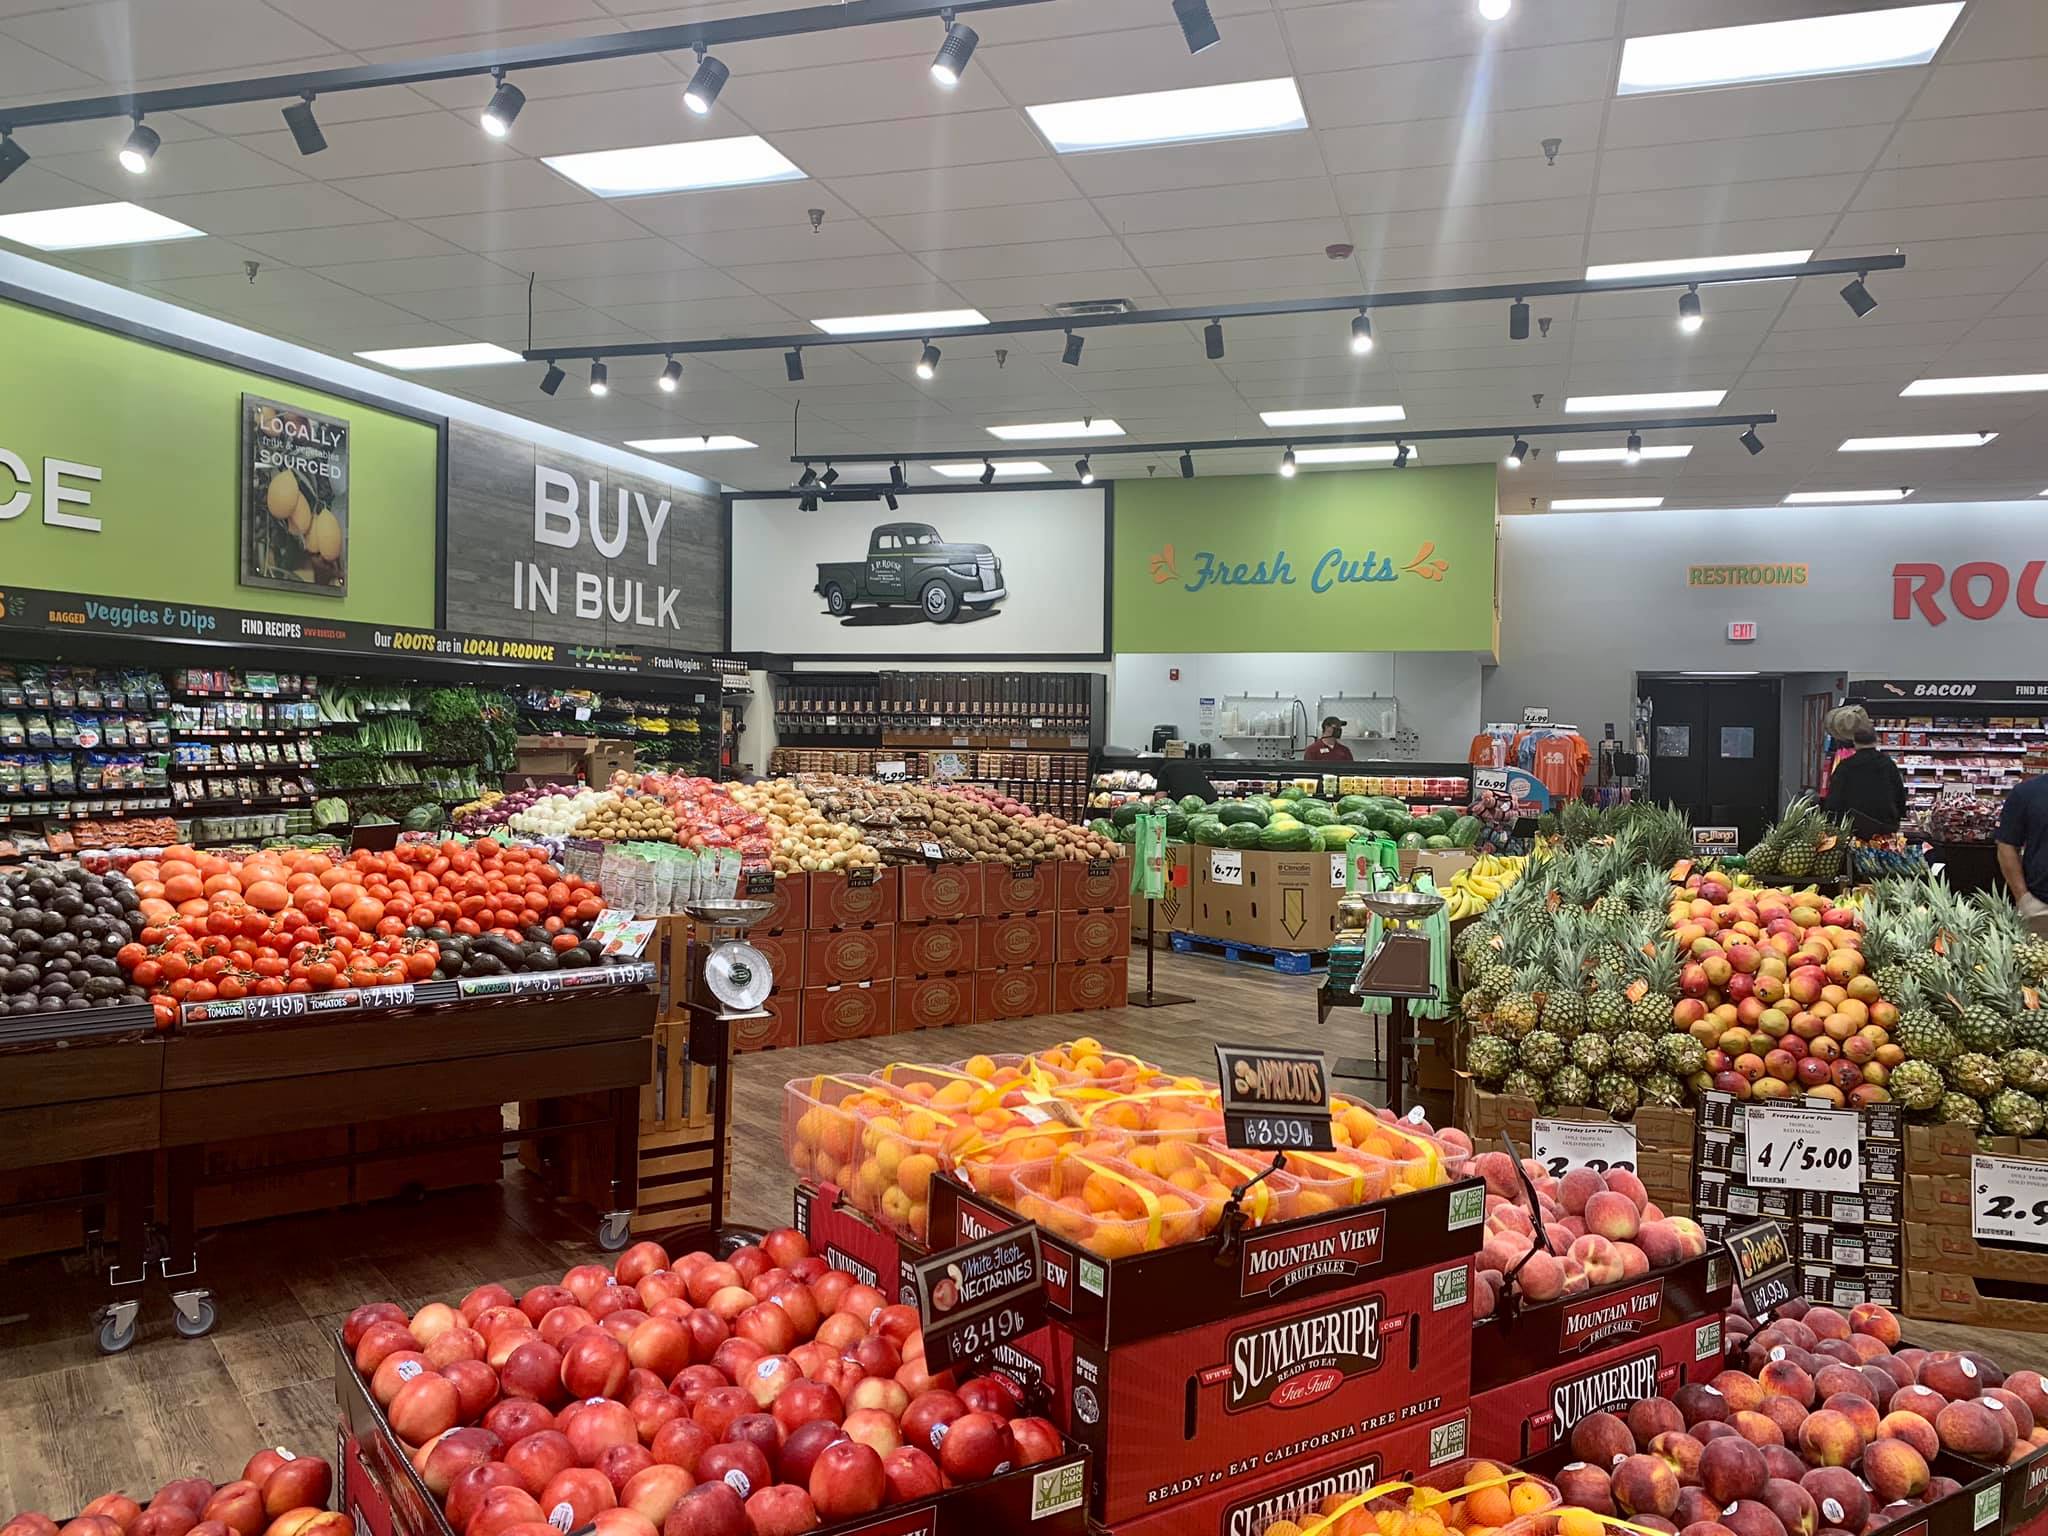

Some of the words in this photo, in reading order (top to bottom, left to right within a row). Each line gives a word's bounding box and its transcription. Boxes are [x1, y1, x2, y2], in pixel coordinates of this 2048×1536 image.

[260, 414, 341, 448] LOCALLY
[260, 449, 341, 479] SOURCED
[535, 464, 672, 566] BUY
[1185, 550, 1297, 592] Fresh
[1311, 548, 1399, 594] Cuts
[1688, 566, 1807, 585] RESTROOMS
[514, 561, 558, 614] IN
[576, 571, 681, 630] BULK
[49, 611, 85, 624] BAGGED
[85, 601, 159, 628] Veggies
[163, 607, 176, 625] &
[180, 610, 216, 634] Dips
[241, 619, 264, 635] FIND
[265, 621, 301, 639] RECIPES
[1733, 624, 1754, 638] EXIT
[374, 631, 391, 647] Our
[393, 632, 436, 651] ROOTS
[437, 640, 451, 652] are
[453, 638, 461, 653] in
[463, 639, 500, 657] LOCAL
[502, 642, 555, 660] PRODUCE
[654, 656, 674, 668] Fresh
[674, 657, 700, 672] Veggies
[1914, 684, 1977, 696] BACON
[2015, 686, 2036, 695] FIND
[207, 1005, 243, 1018] TOMATOES
[310, 998, 346, 1009] TOMATOES
[1256, 1058, 1322, 1103] APRICOTS
[961, 1253, 992, 1282] White
[993, 1241, 1025, 1269] Flesh
[1249, 1237, 1336, 1275] MOUNTAIN
[1340, 1227, 1380, 1252] VIEW
[960, 1259, 1032, 1303] NECTARINES
[1285, 1266, 1316, 1286] FRUIT
[1316, 1261, 1345, 1274] SALES
[1452, 1268, 1467, 1279] NON
[1566, 1302, 1628, 1336] MOUNTAIN
[1630, 1291, 1660, 1314] VIEW
[1590, 1325, 1613, 1343] FRUIT
[1613, 1320, 1633, 1332] SALES
[1205, 1367, 1232, 1381] www.
[1233, 1302, 1379, 1402] SUMMERIPE
[1381, 1319, 1402, 1331] .com
[1278, 1363, 1306, 1383] READY
[1309, 1359, 1320, 1368] TO
[1322, 1358, 1336, 1366] EAT
[1279, 1382, 1305, 1404] Tree
[1305, 1375, 1334, 1396] Fruit
[1554, 1354, 1658, 1441] SUMMERIPE
[1149, 1476, 1205, 1503] READY
[1210, 1471, 1222, 1481] to
[1229, 1457, 1259, 1475] EAT
[1265, 1426, 1355, 1463] CALIFORNIA
[1361, 1412, 1396, 1432] TREE
[1402, 1397, 1441, 1418] FRUIT
[1063, 1465, 1083, 1478] NON
[1063, 1474, 1083, 1486] GMO
[1037, 1490, 1082, 1509] VERIFIED
